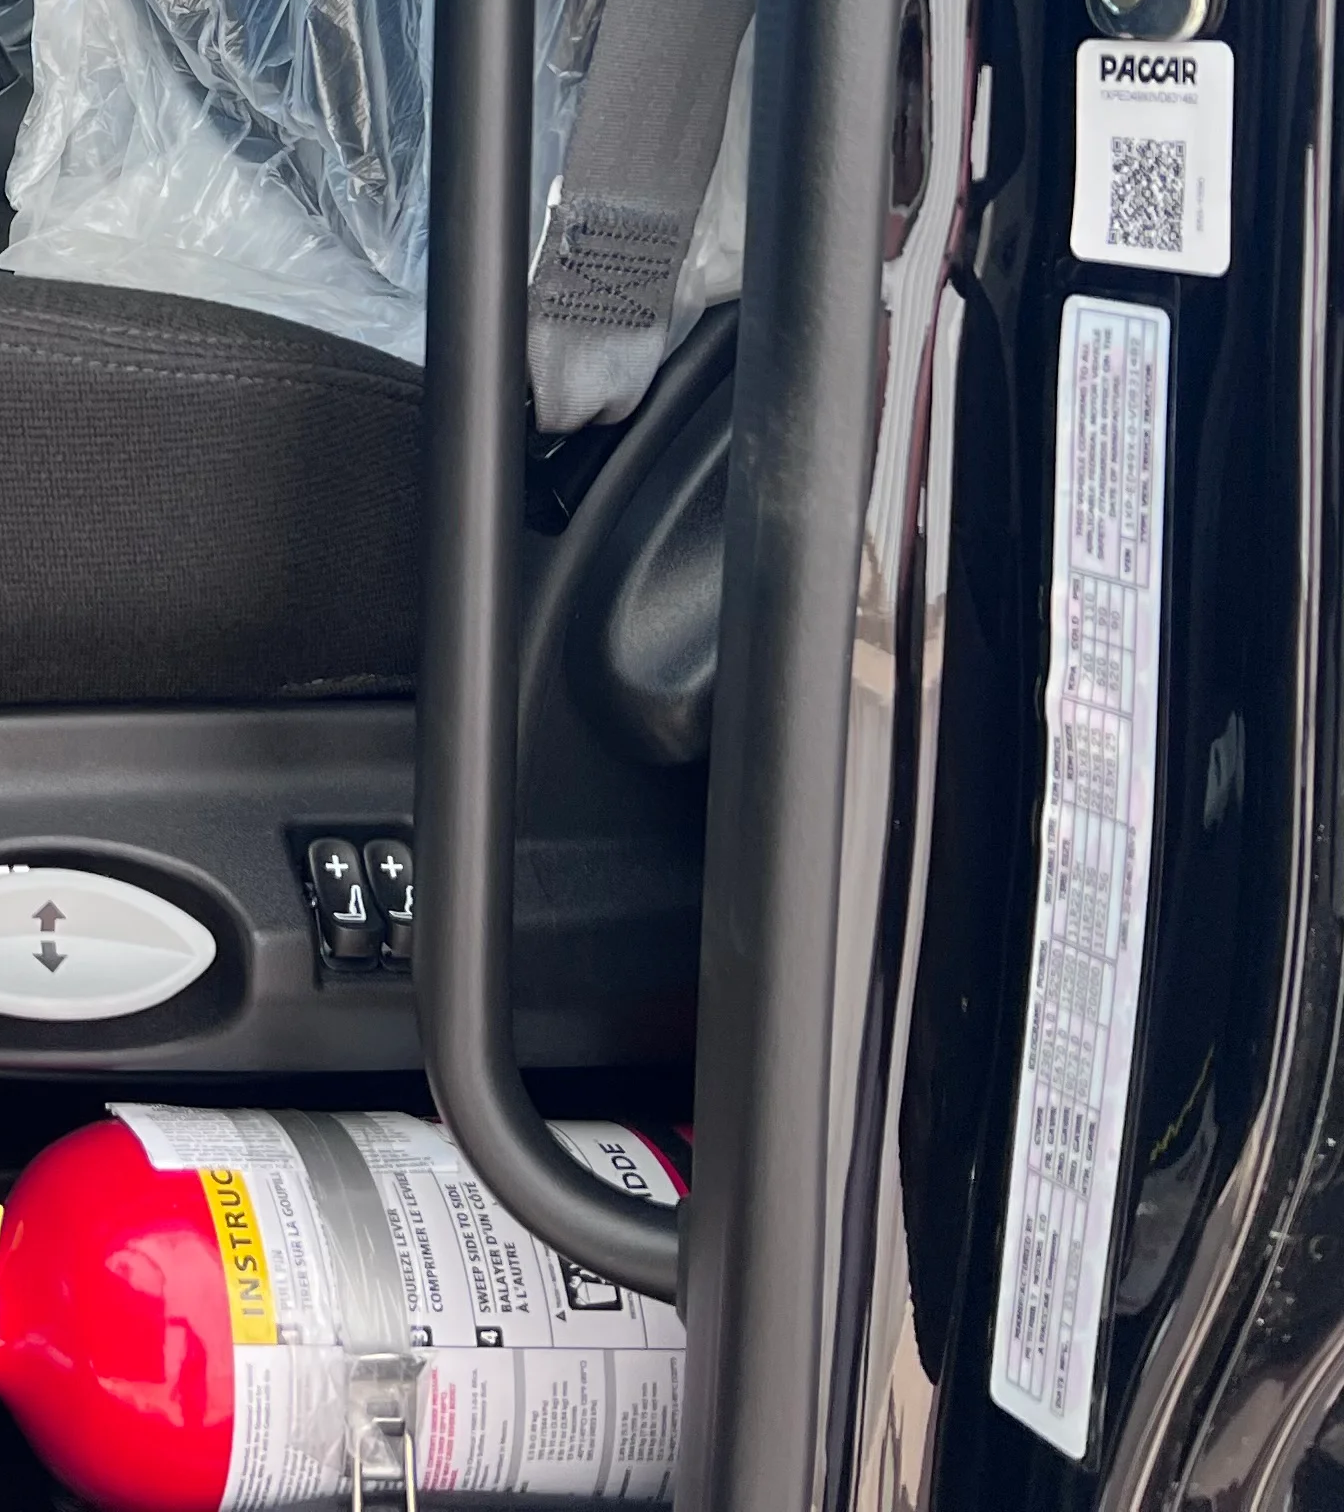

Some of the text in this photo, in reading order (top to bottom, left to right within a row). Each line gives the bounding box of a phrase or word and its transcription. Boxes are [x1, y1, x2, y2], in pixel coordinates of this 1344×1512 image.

[1100, 54, 1198, 86] PACCAR
[599, 1142, 653, 1199] IDDE
[411, 1209, 424, 1224] LE
[462, 1181, 486, 1210] CÔTÉ
[285, 1220, 299, 1237] LA
[444, 1183, 492, 1313] SWEEP SIDE TO SIDE
[291, 1240, 307, 1267] SUR
[386, 1207, 420, 1313] SQUEEZE LEVER
[415, 1227, 444, 1313] COMPRIMER
[489, 1248, 513, 1313] BALAYER
[503, 1241, 531, 1314] À L'AUTRE
[479, 1329, 498, 1344] 4
